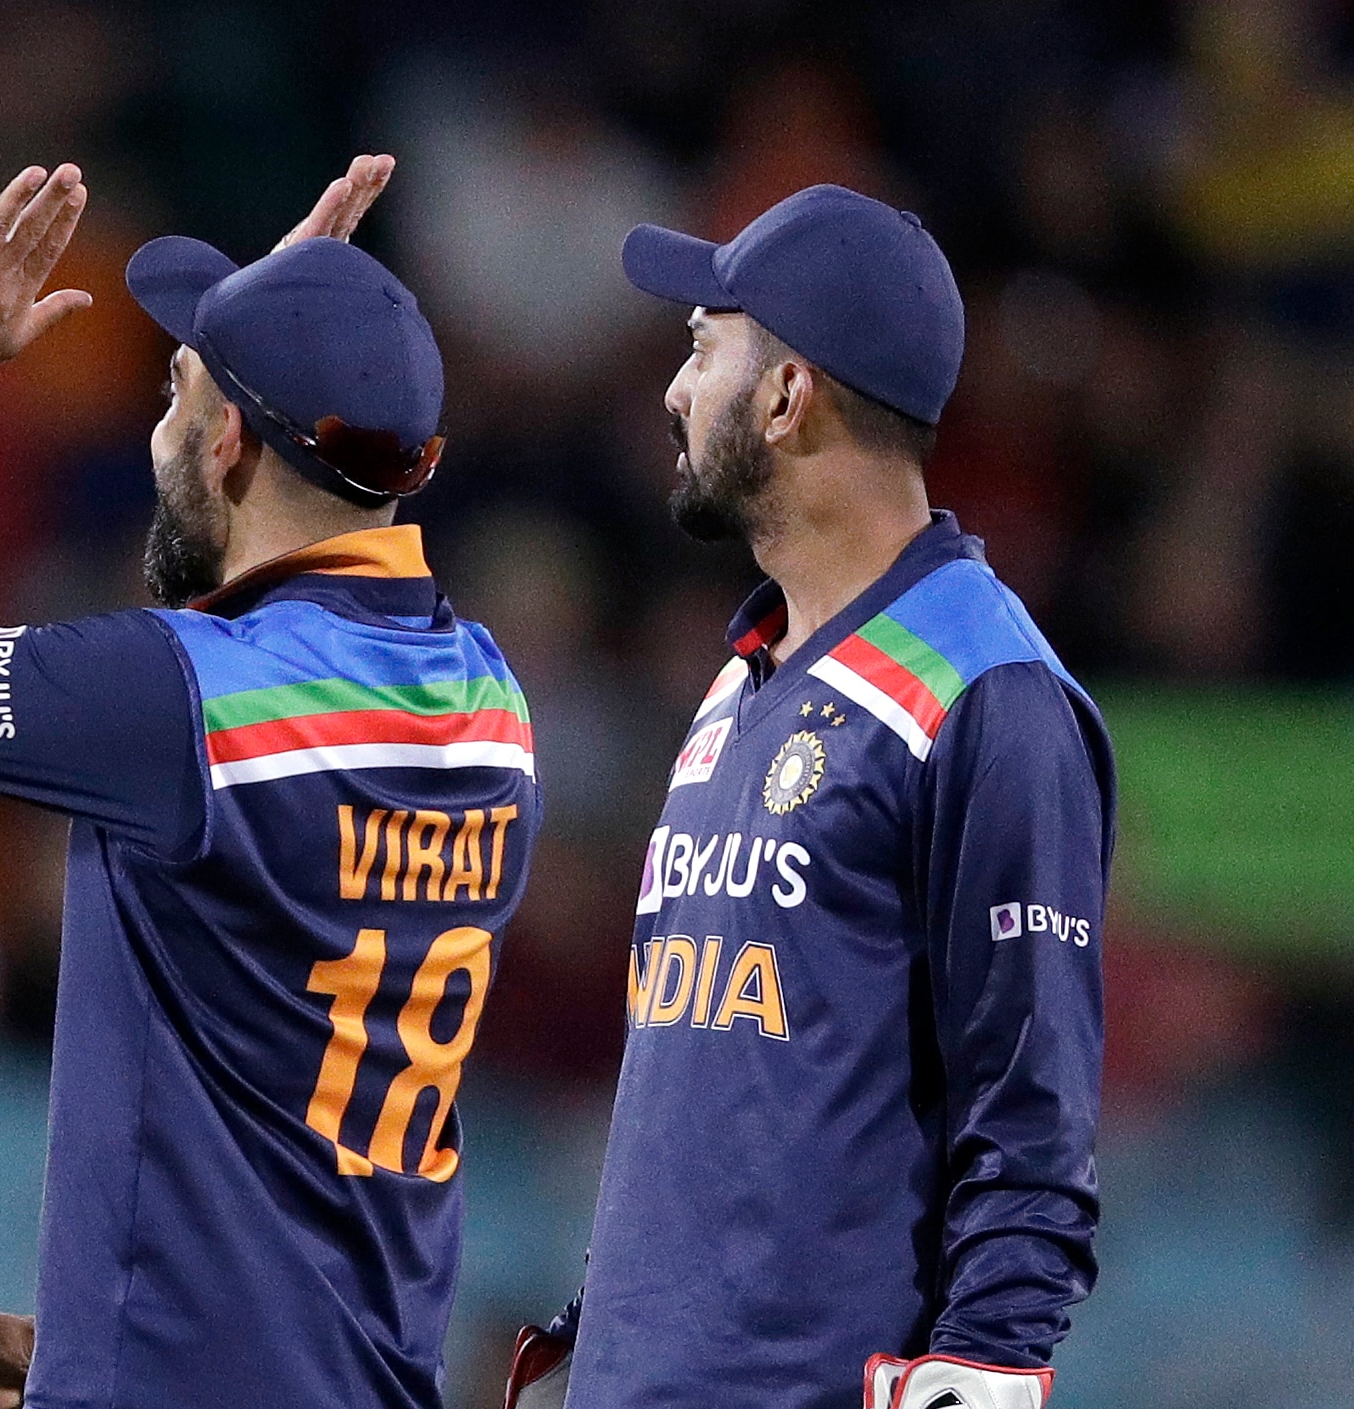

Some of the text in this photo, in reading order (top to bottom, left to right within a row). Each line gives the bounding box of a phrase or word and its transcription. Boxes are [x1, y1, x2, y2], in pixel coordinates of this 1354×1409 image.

[337, 804, 518, 901] VIRAT
[663, 832, 811, 908] BYJU'S
[627, 934, 790, 1041] NDIA
[306, 926, 493, 1182] 18
